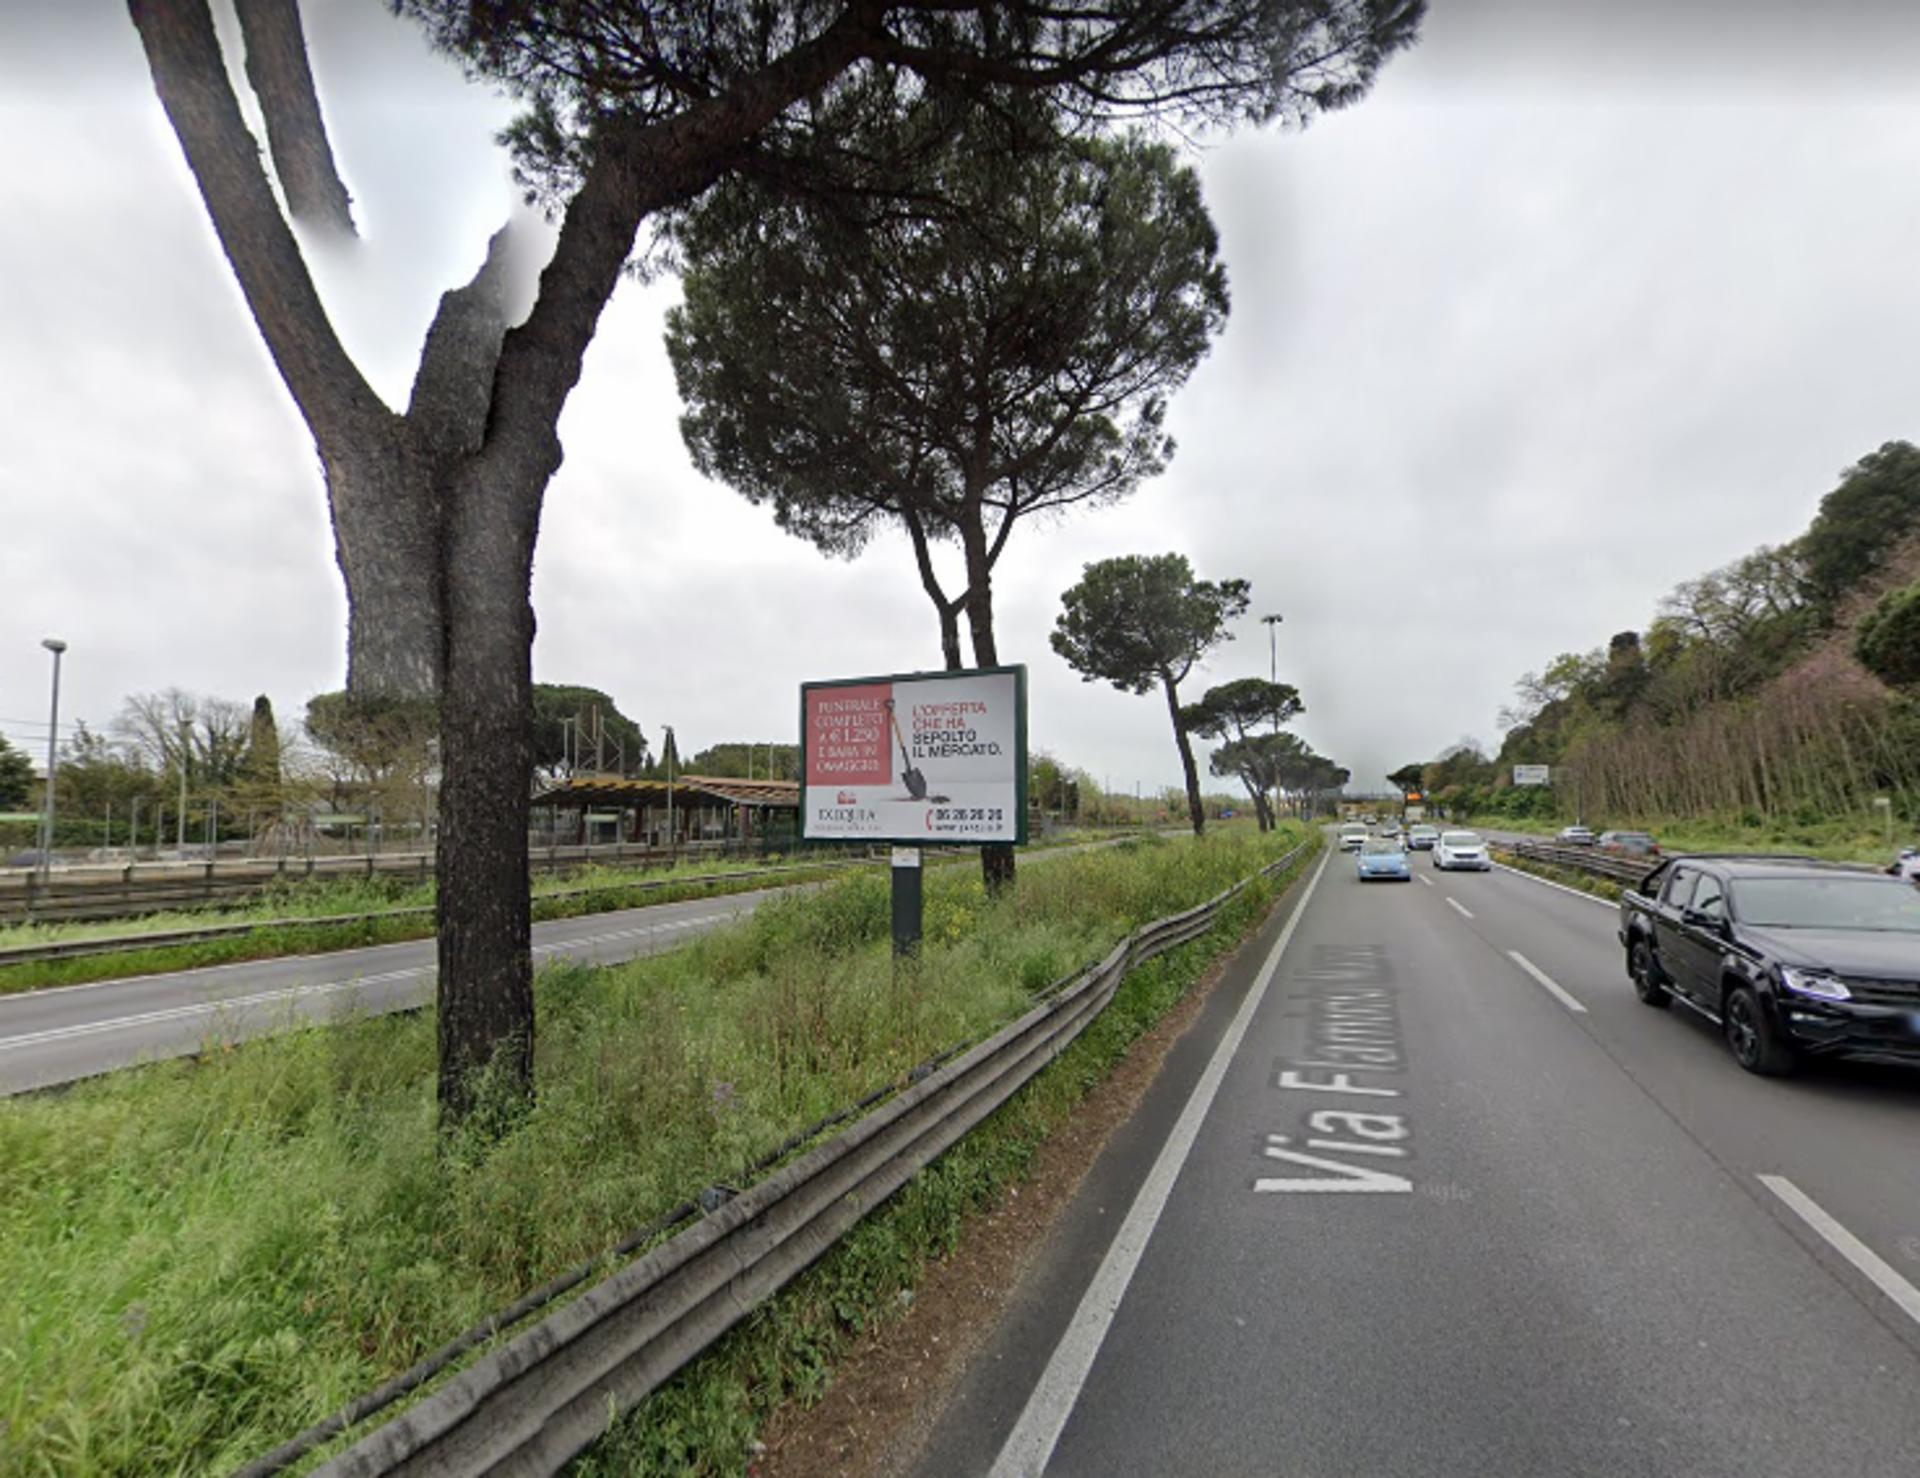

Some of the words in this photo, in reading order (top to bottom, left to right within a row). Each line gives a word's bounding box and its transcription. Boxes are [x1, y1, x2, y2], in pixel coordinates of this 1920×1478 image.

[818, 699, 880, 714] FUNERALE
[912, 701, 987, 716] L'OFFERTA
[912, 718, 942, 731] CHE
[946, 717, 966, 730] HA
[912, 729, 977, 745] SEPOLTO
[912, 746, 926, 758] IL
[928, 742, 1003, 758] MERCATO.
